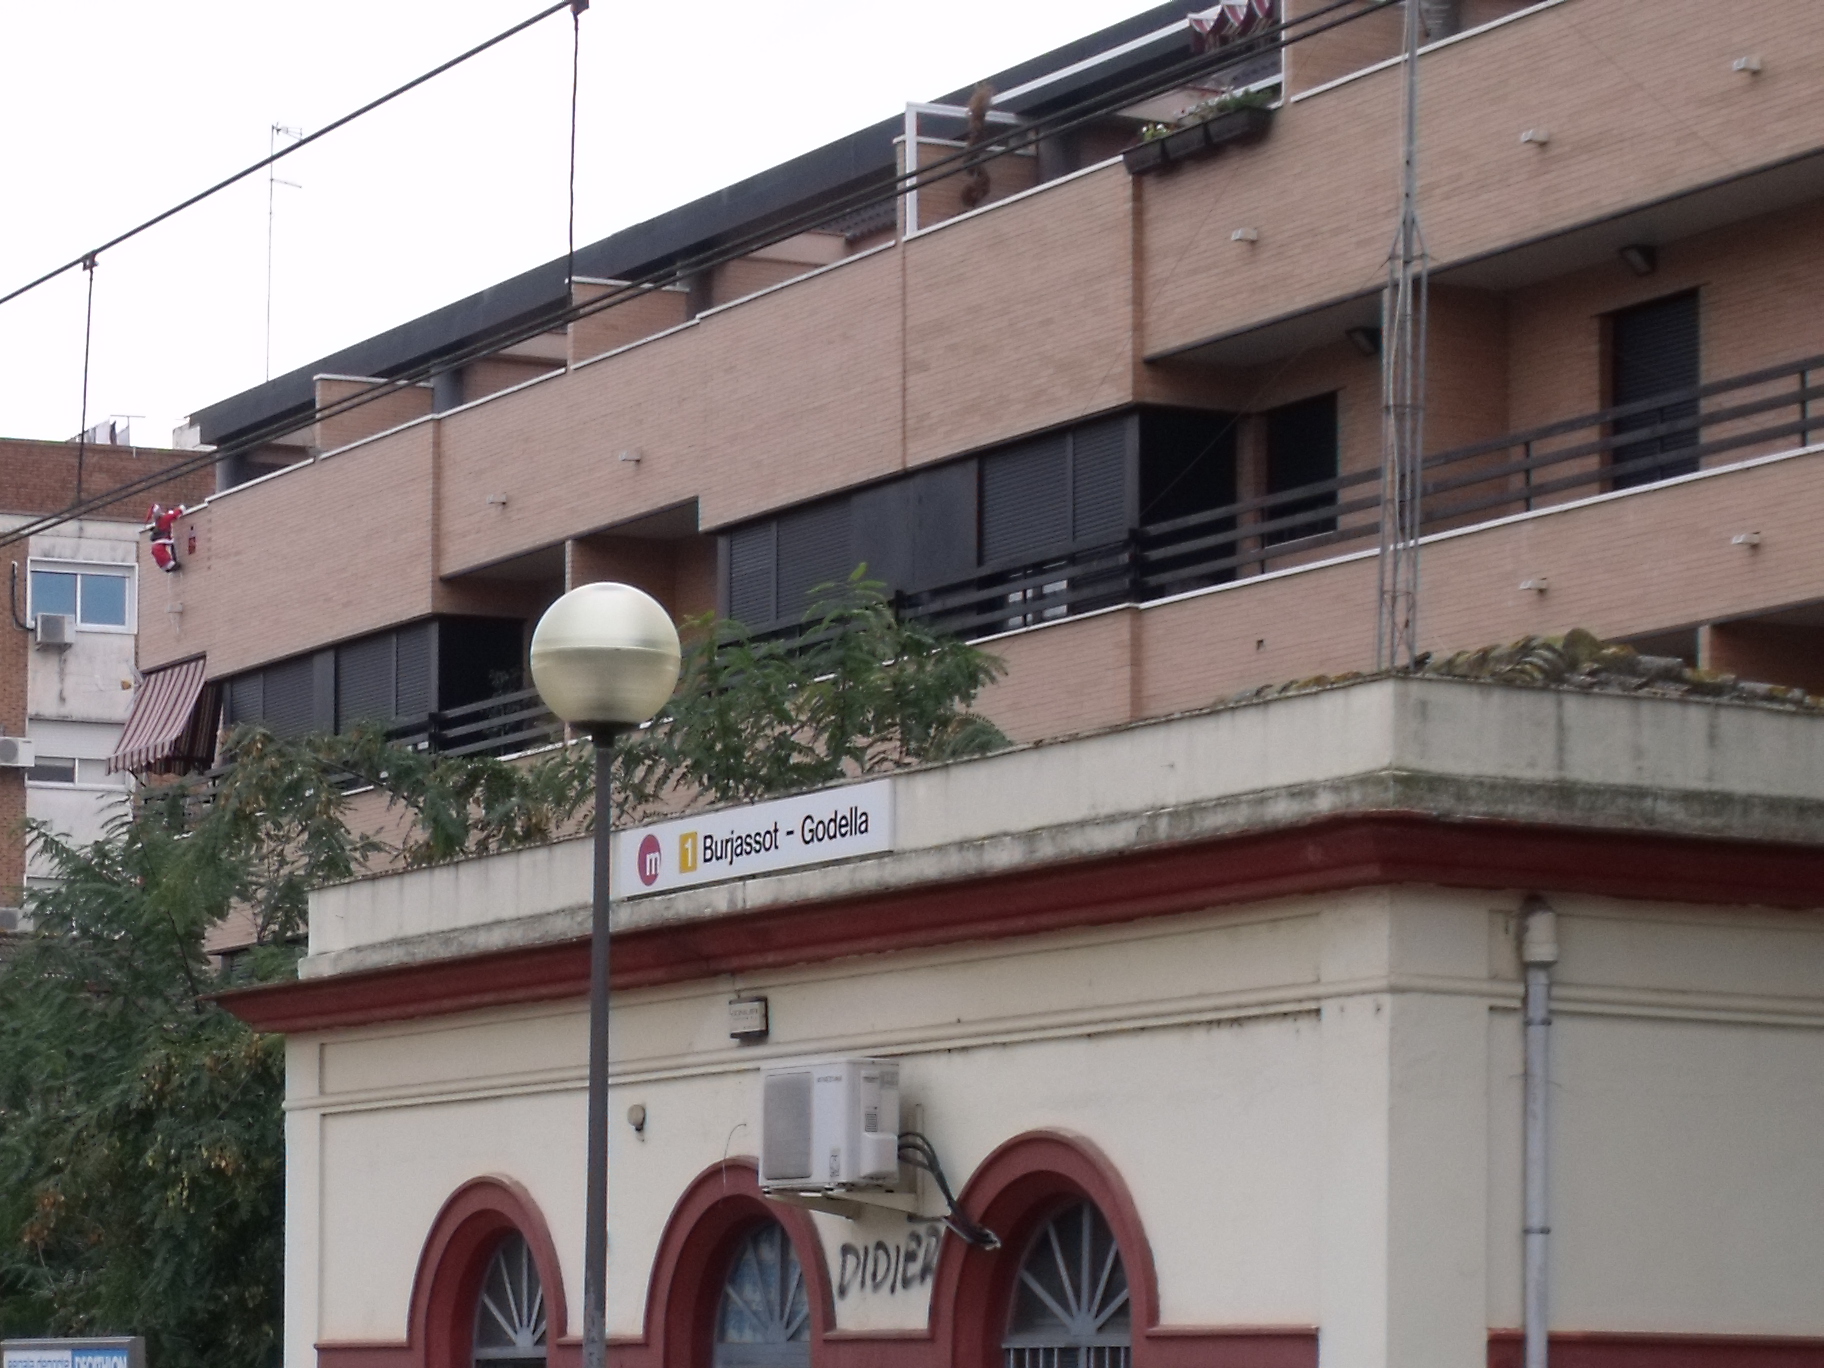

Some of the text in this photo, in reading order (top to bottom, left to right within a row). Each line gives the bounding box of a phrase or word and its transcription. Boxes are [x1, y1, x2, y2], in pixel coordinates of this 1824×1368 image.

[703, 821, 780, 866] Burjassot
[800, 805, 869, 845] Godella
[838, 1225, 942, 1300] DIDIER
